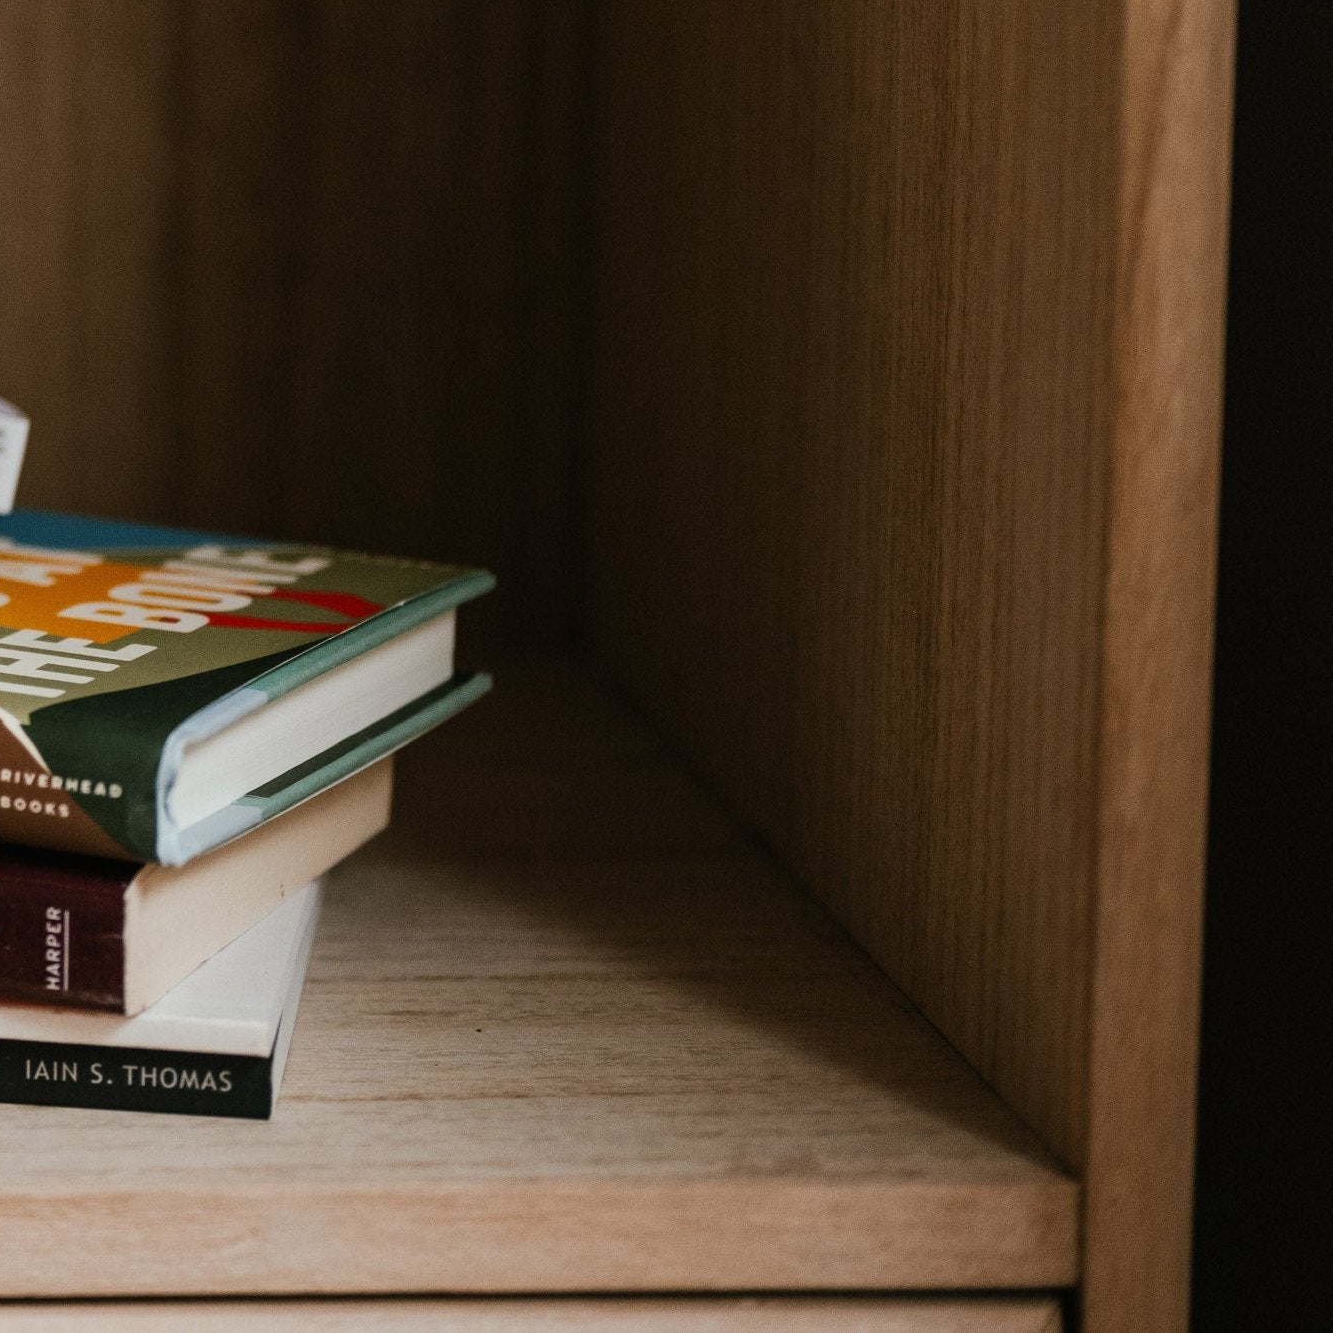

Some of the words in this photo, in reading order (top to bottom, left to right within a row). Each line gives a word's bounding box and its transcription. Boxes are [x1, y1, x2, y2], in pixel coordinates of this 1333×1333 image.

[57, 545, 331, 633] BONE
[0, 769, 123, 799] RIVERHEAD
[0, 796, 71, 818] BOOKS
[45, 906, 62, 991] HARPER
[24, 1058, 79, 1084] IAIN
[90, 1062, 114, 1085] S.
[122, 1064, 234, 1093] THOMAS
